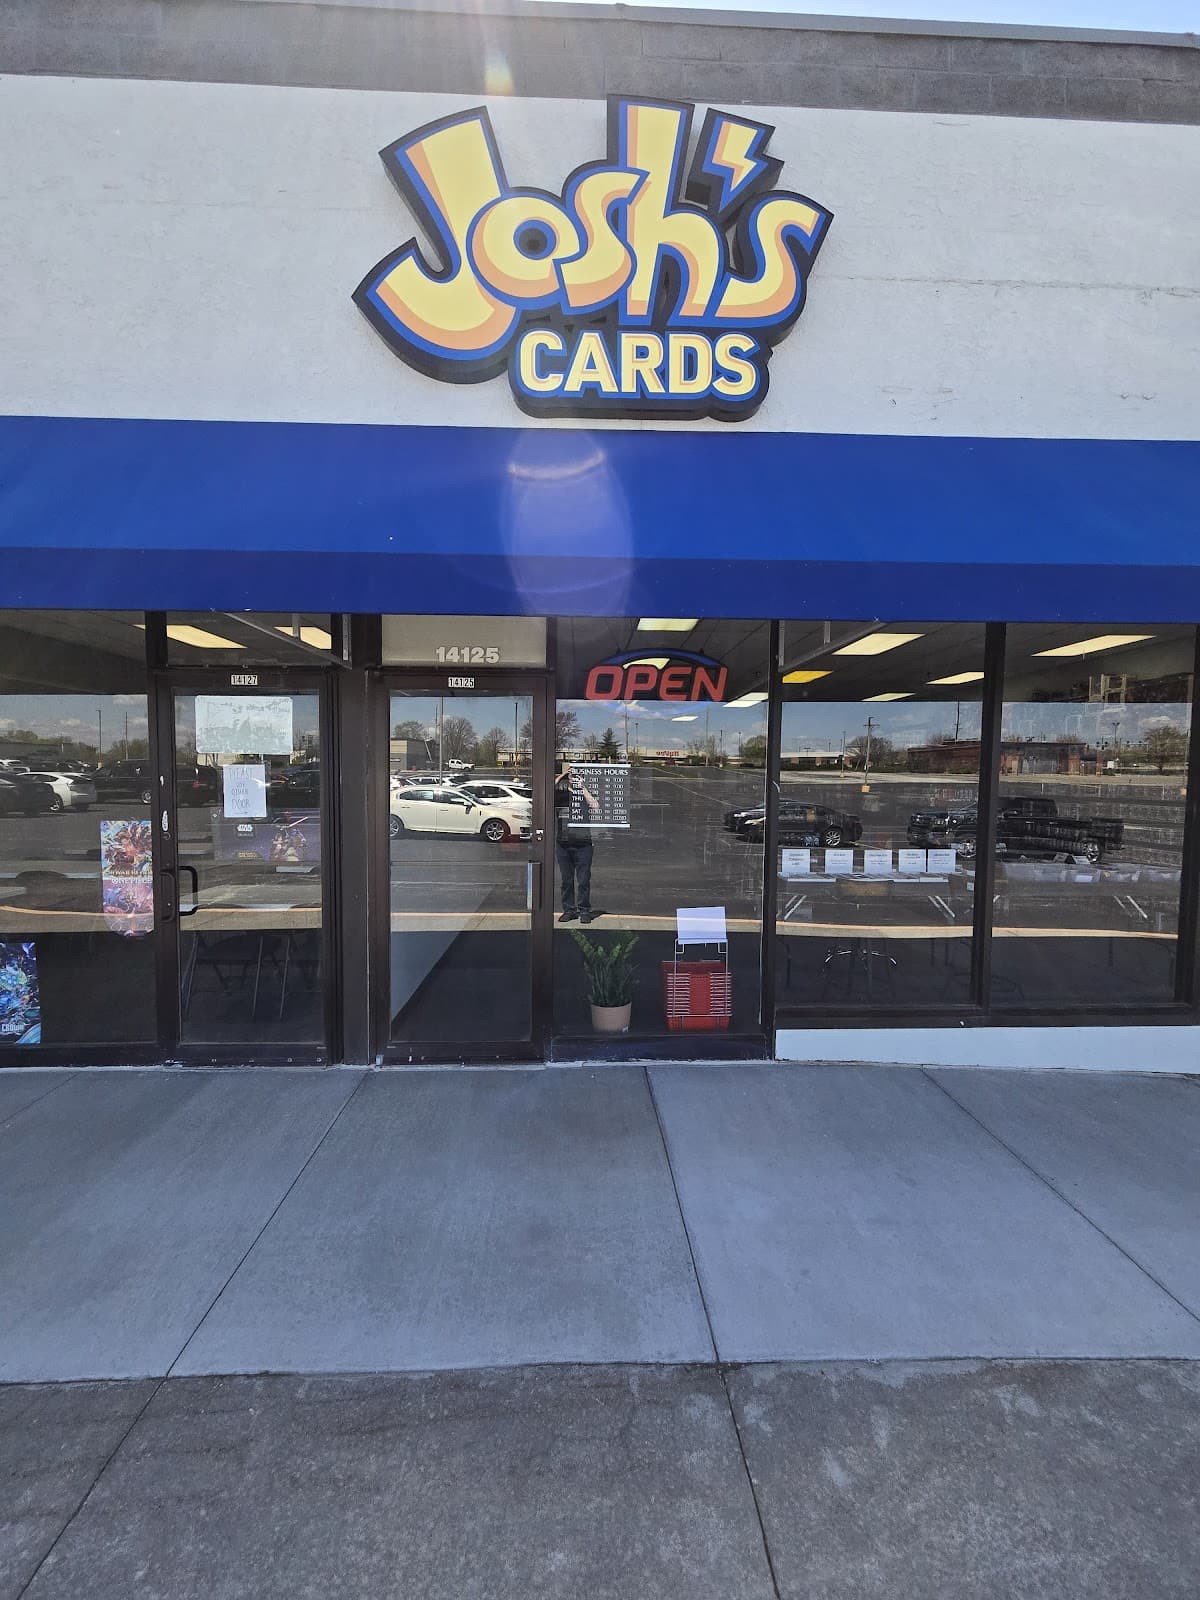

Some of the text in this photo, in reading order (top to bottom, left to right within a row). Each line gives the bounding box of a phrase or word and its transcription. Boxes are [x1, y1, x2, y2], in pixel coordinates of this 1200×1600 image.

[375, 104, 824, 351] Josh's
[519, 331, 757, 396] CARDS
[436, 647, 500, 663] 14125
[231, 675, 257, 685] 14127
[448, 678, 474, 687] 14125
[585, 665, 728, 702] OPEN
[570, 768, 629, 776] BUSINESS HOURS
